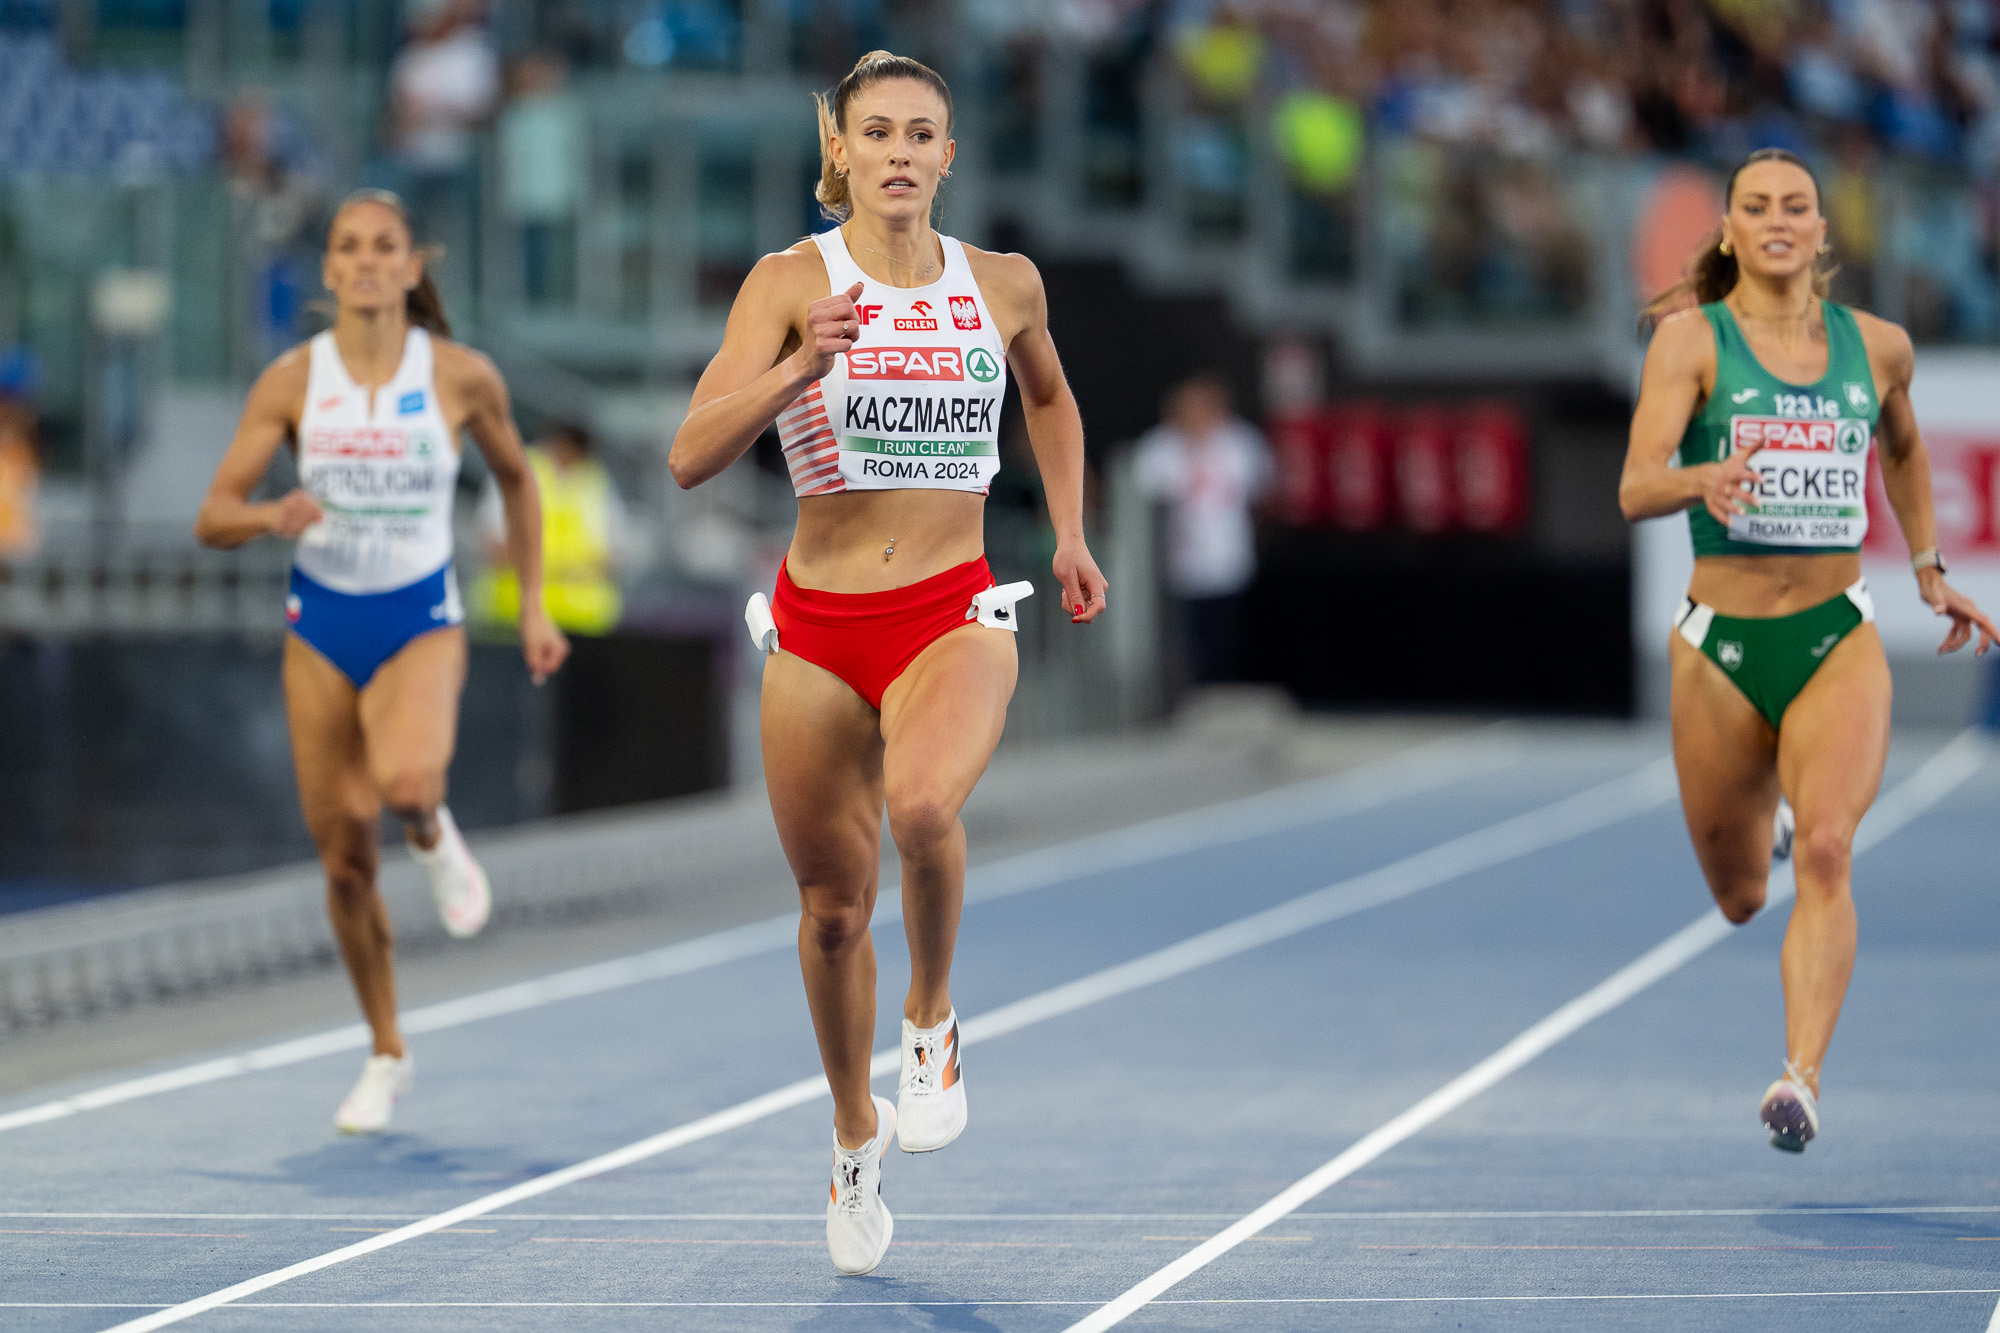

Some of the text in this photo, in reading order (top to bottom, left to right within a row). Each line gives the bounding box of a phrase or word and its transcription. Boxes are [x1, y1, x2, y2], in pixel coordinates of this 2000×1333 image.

[896, 320, 935, 330] ORLEN
[850, 351, 961, 375] SPAR
[846, 395, 996, 433] KACZMAREK
[1738, 422, 1834, 450] SPAR
[876, 440, 881, 452] I
[884, 441, 916, 455] RUN
[863, 458, 980, 480] ROMA 2024
[1749, 520, 1850, 540] ROMA 2024
